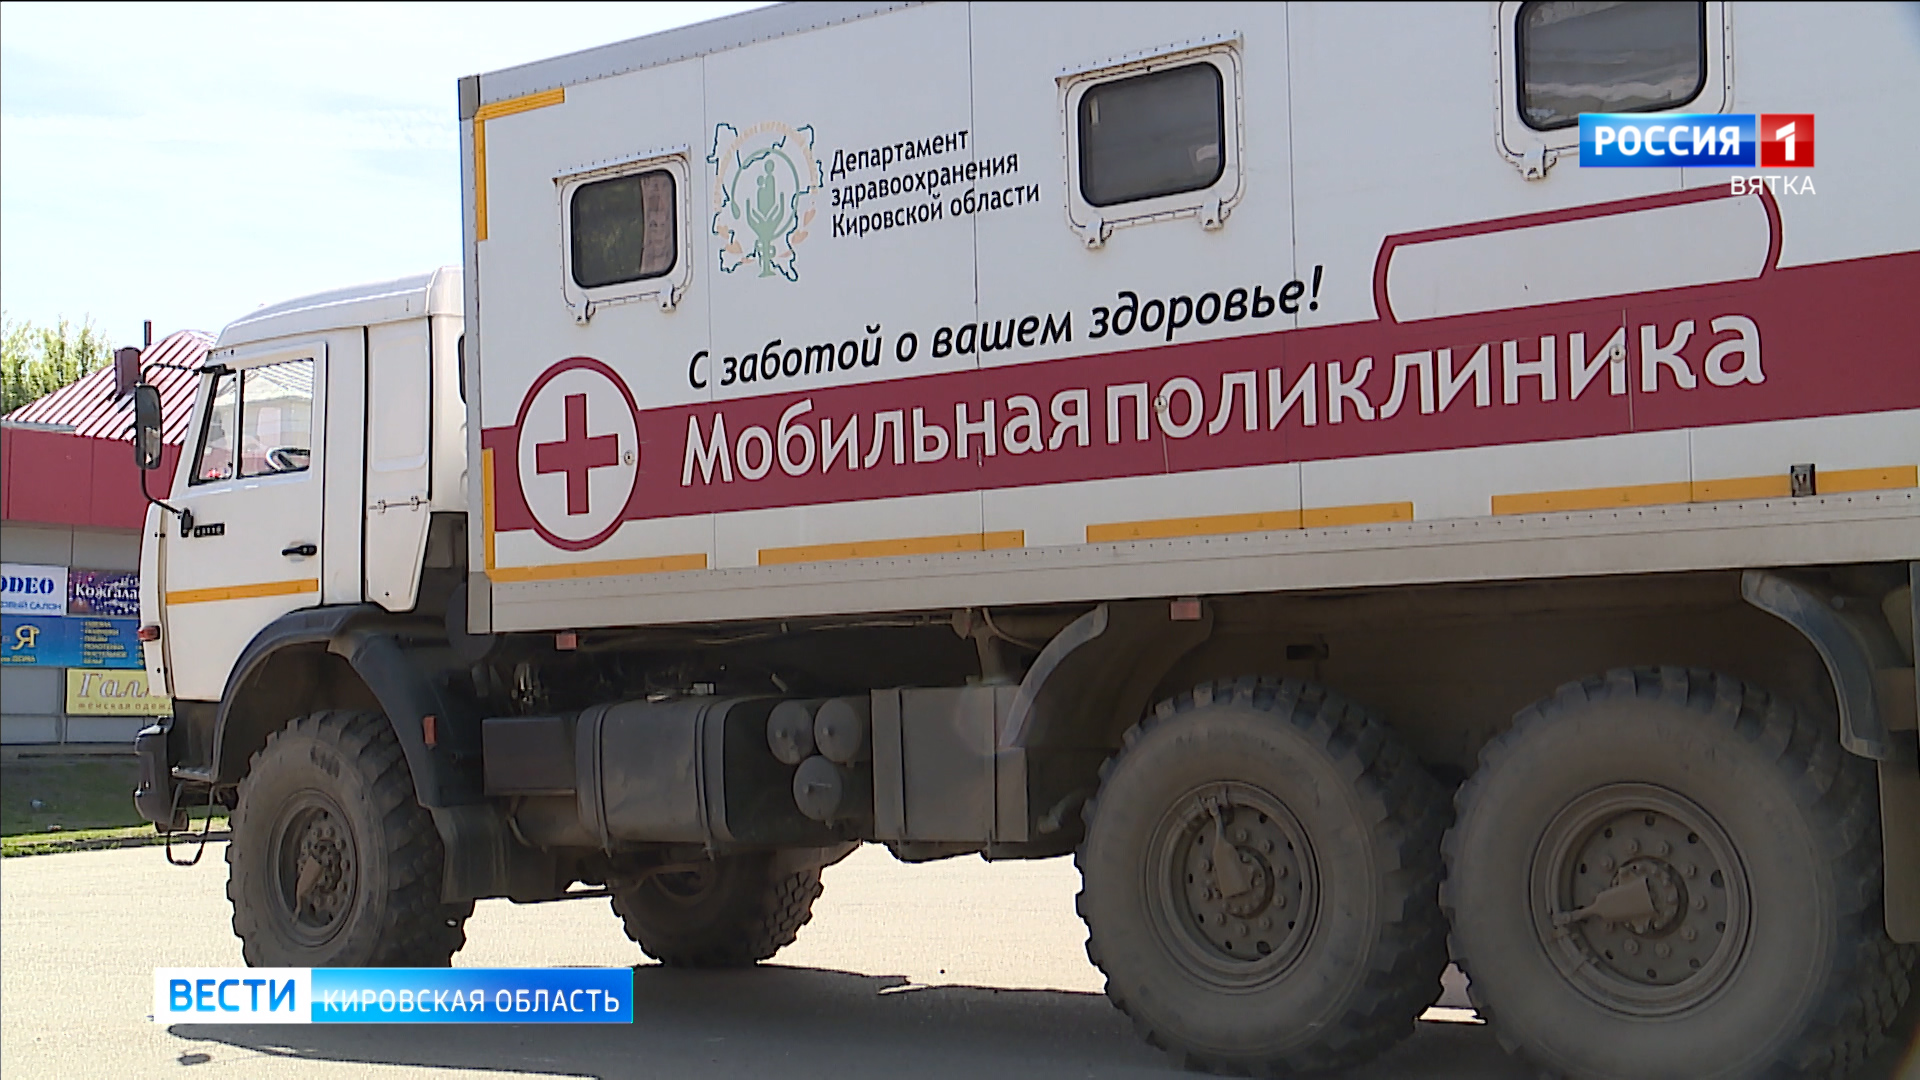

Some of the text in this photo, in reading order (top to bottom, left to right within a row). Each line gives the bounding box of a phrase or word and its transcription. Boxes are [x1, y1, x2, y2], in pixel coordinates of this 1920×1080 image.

[829, 129, 969, 181] Департамент
[831, 152, 1019, 209] здравоохранения
[832, 183, 1040, 238] Кировской области
[688, 264, 1324, 389] С заботой о вашем здоровье!
[680, 313, 1766, 487] Мобильная поликлиника
[10, 624, 40, 650] Я
[77, 671, 150, 699] Гал
